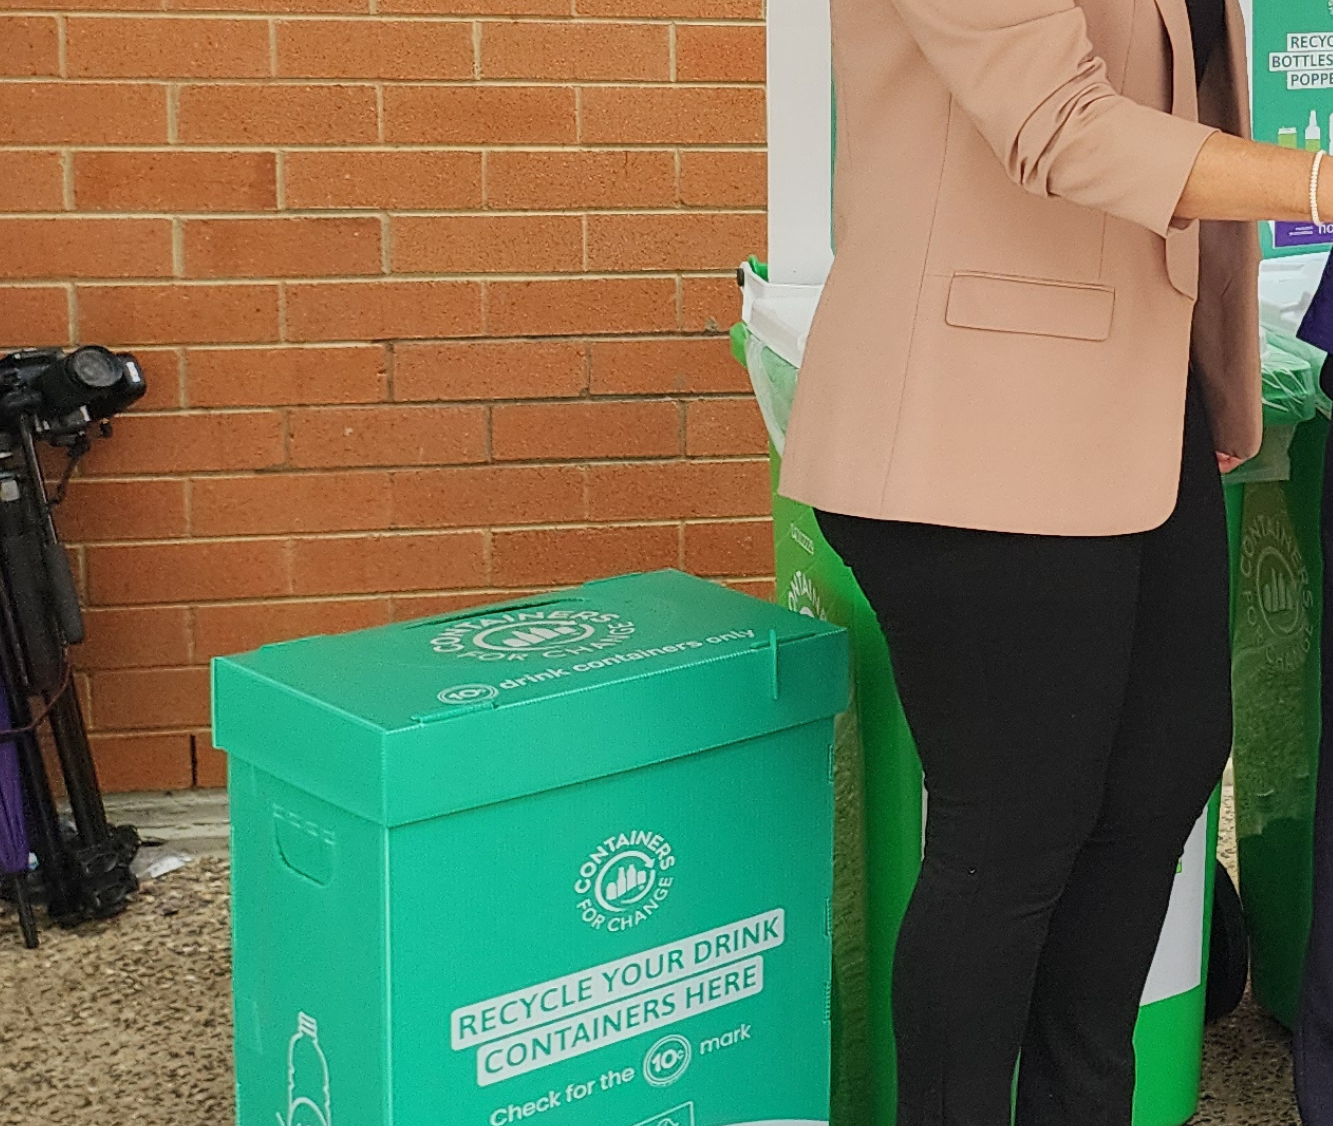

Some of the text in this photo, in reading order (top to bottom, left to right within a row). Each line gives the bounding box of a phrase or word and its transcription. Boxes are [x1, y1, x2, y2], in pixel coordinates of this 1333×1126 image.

[430, 610, 620, 653] CONTAINERS
[500, 628, 757, 691] drink containers only
[542, 620, 636, 660] CHANGE
[574, 830, 676, 894] CONTAINERS
[576, 877, 674, 932] FOR CHANGE
[458, 915, 780, 1041] RECYCLE YOUR DRINK
[484, 964, 758, 1074] CONTAINERS HERE
[489, 1024, 752, 1125] Check for the mark
